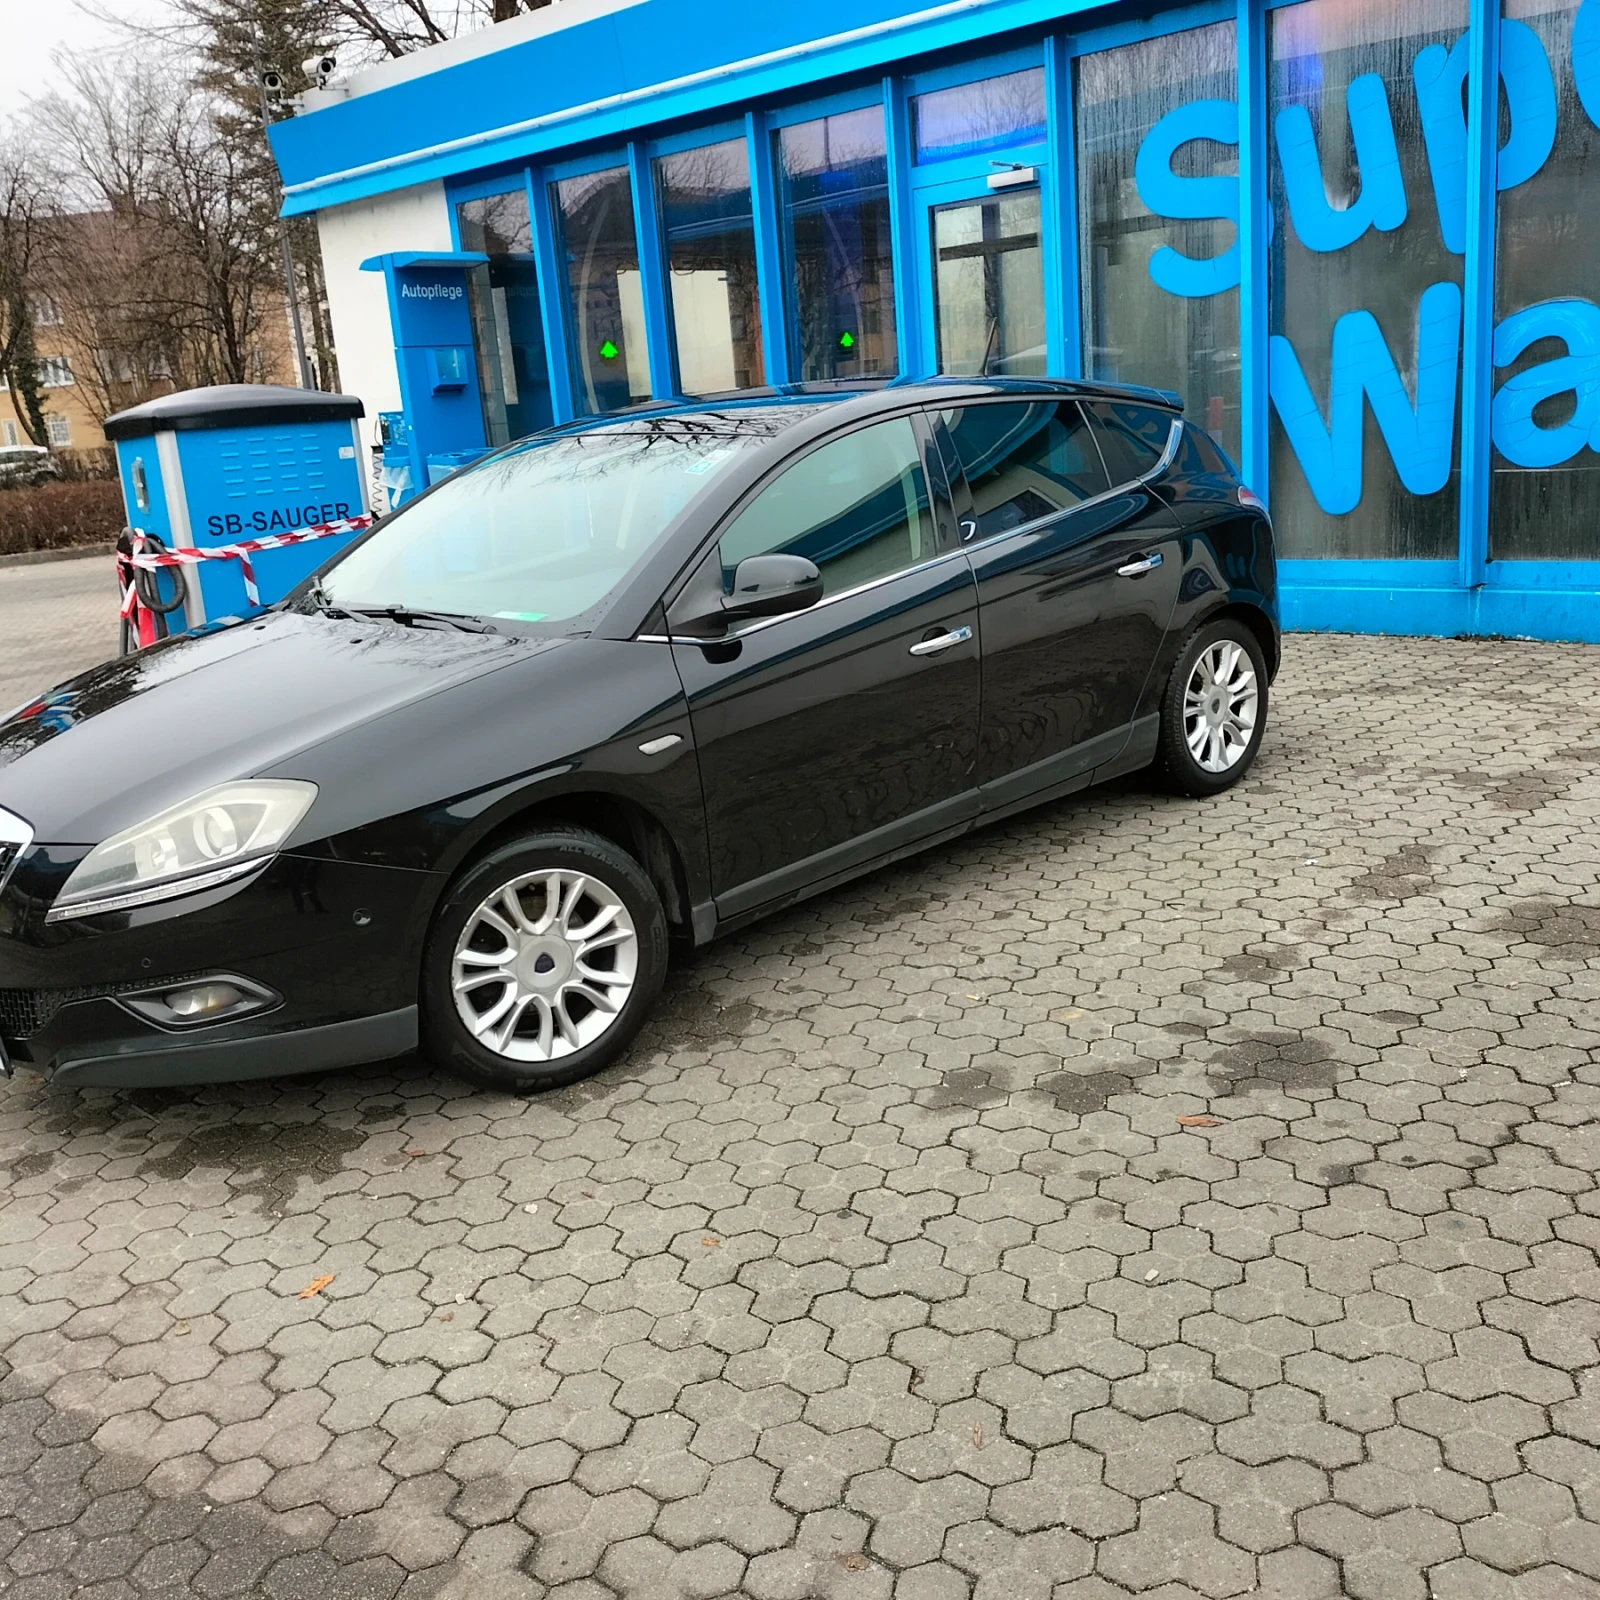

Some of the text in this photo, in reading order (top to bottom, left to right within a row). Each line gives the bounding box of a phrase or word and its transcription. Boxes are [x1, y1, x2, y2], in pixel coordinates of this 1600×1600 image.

[1135, 0, 1600, 297] Sup
[401, 283, 463, 300] Autopflege
[207, 502, 350, 536] SB-SAUGER
